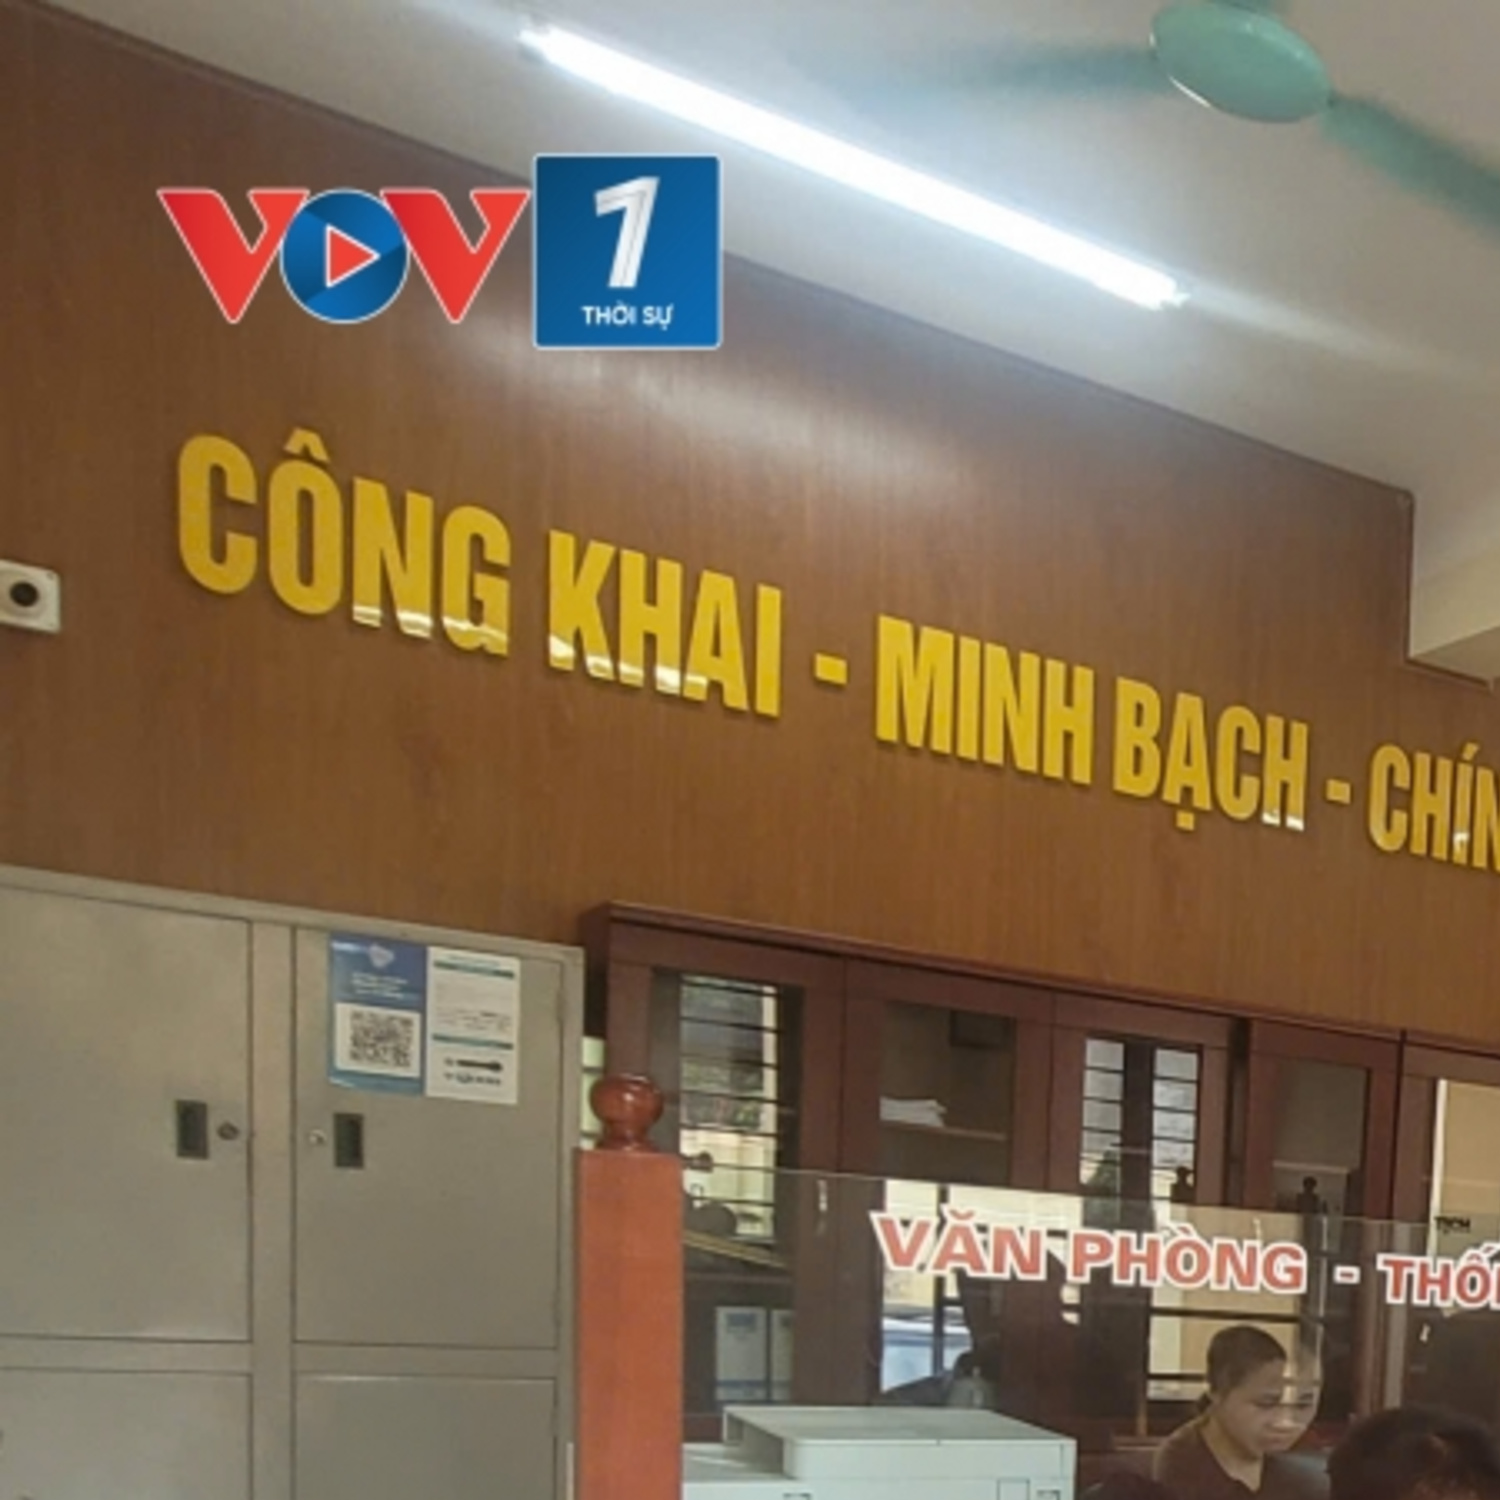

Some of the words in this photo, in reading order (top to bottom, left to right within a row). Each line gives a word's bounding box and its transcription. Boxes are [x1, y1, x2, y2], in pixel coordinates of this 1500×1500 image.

[178, 427, 511, 657] CÔNG
[548, 529, 783, 718] KHAI
[875, 614, 1096, 787] MINH
[1112, 676, 1309, 832] BẠCH
[870, 1204, 1048, 1281] VĂN
[1066, 1222, 1307, 1294] PHÒNG
